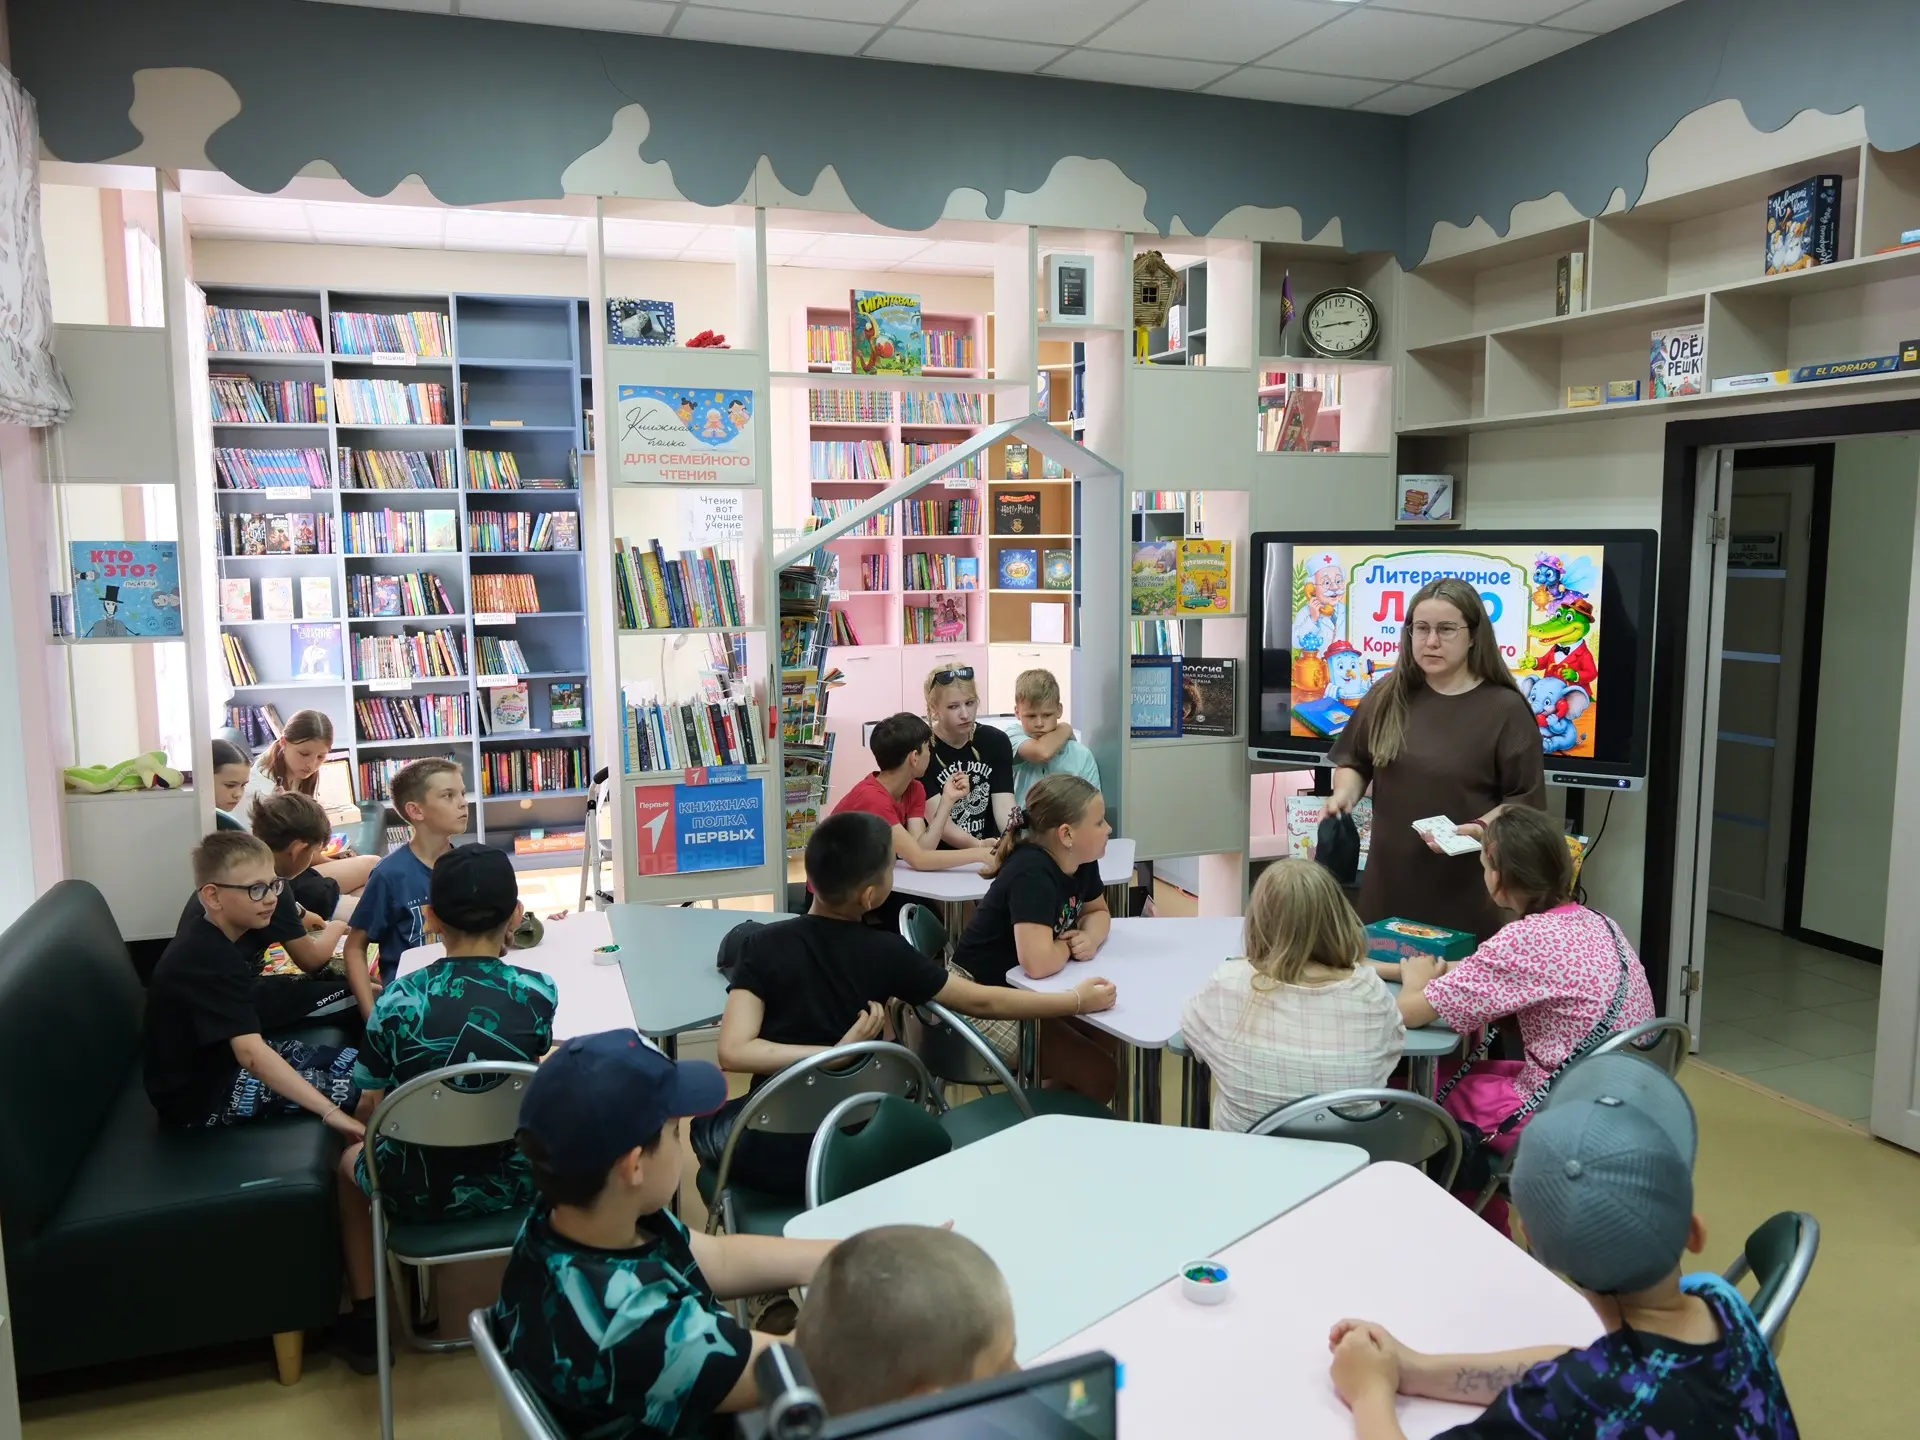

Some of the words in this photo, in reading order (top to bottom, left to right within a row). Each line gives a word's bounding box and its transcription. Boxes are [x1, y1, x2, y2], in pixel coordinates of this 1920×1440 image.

[1324, 300, 1332, 309] 11
[1334, 298, 1346, 308] 12
[1314, 309, 1325, 318] 10
[1357, 307, 1365, 317] 2
[1311, 320, 1319, 329] 9
[1360, 318, 1368, 328] 3
[1315, 331, 1322, 340] 8
[1356, 330, 1364, 339] 4
[1325, 339, 1333, 348] 7
[1336, 342, 1344, 350] 6
[1349, 339, 1356, 348] 5
[1815, 367, 1827, 376] EL
[1830, 361, 1877, 374] DORADO
[621, 406, 694, 441] Книжная
[648, 439, 686, 447] полка
[624, 453, 657, 465] ДЛЯ
[660, 453, 750, 466] СЕМЕЙНОГО
[659, 470, 717, 481] ЧТЕНИЯ
[700, 496, 738, 505] Чтение
[1017, 503, 1034, 514] Potter
[705, 514, 743, 522] лучшее
[705, 522, 741, 531] учение
[1194, 521, 1202, 533] Н
[91, 550, 133, 563] КТО
[104, 564, 158, 577] ЭТО?
[1381, 626, 1395, 634] по
[1364, 636, 1401, 657] Корн
[709, 775, 742, 783] ПЕРВЫХ
[937, 760, 963, 788] rust
[640, 802, 669, 810] Первые
[679, 797, 759, 814] КНИЖНАЯ
[692, 814, 747, 829] ПОЛКА
[961, 818, 985, 833] sion
[684, 828, 755, 845] ПЕРВЫХ
[640, 846, 761, 873] ПЕРВЫЕ
[316, 989, 346, 1007] SPORT
